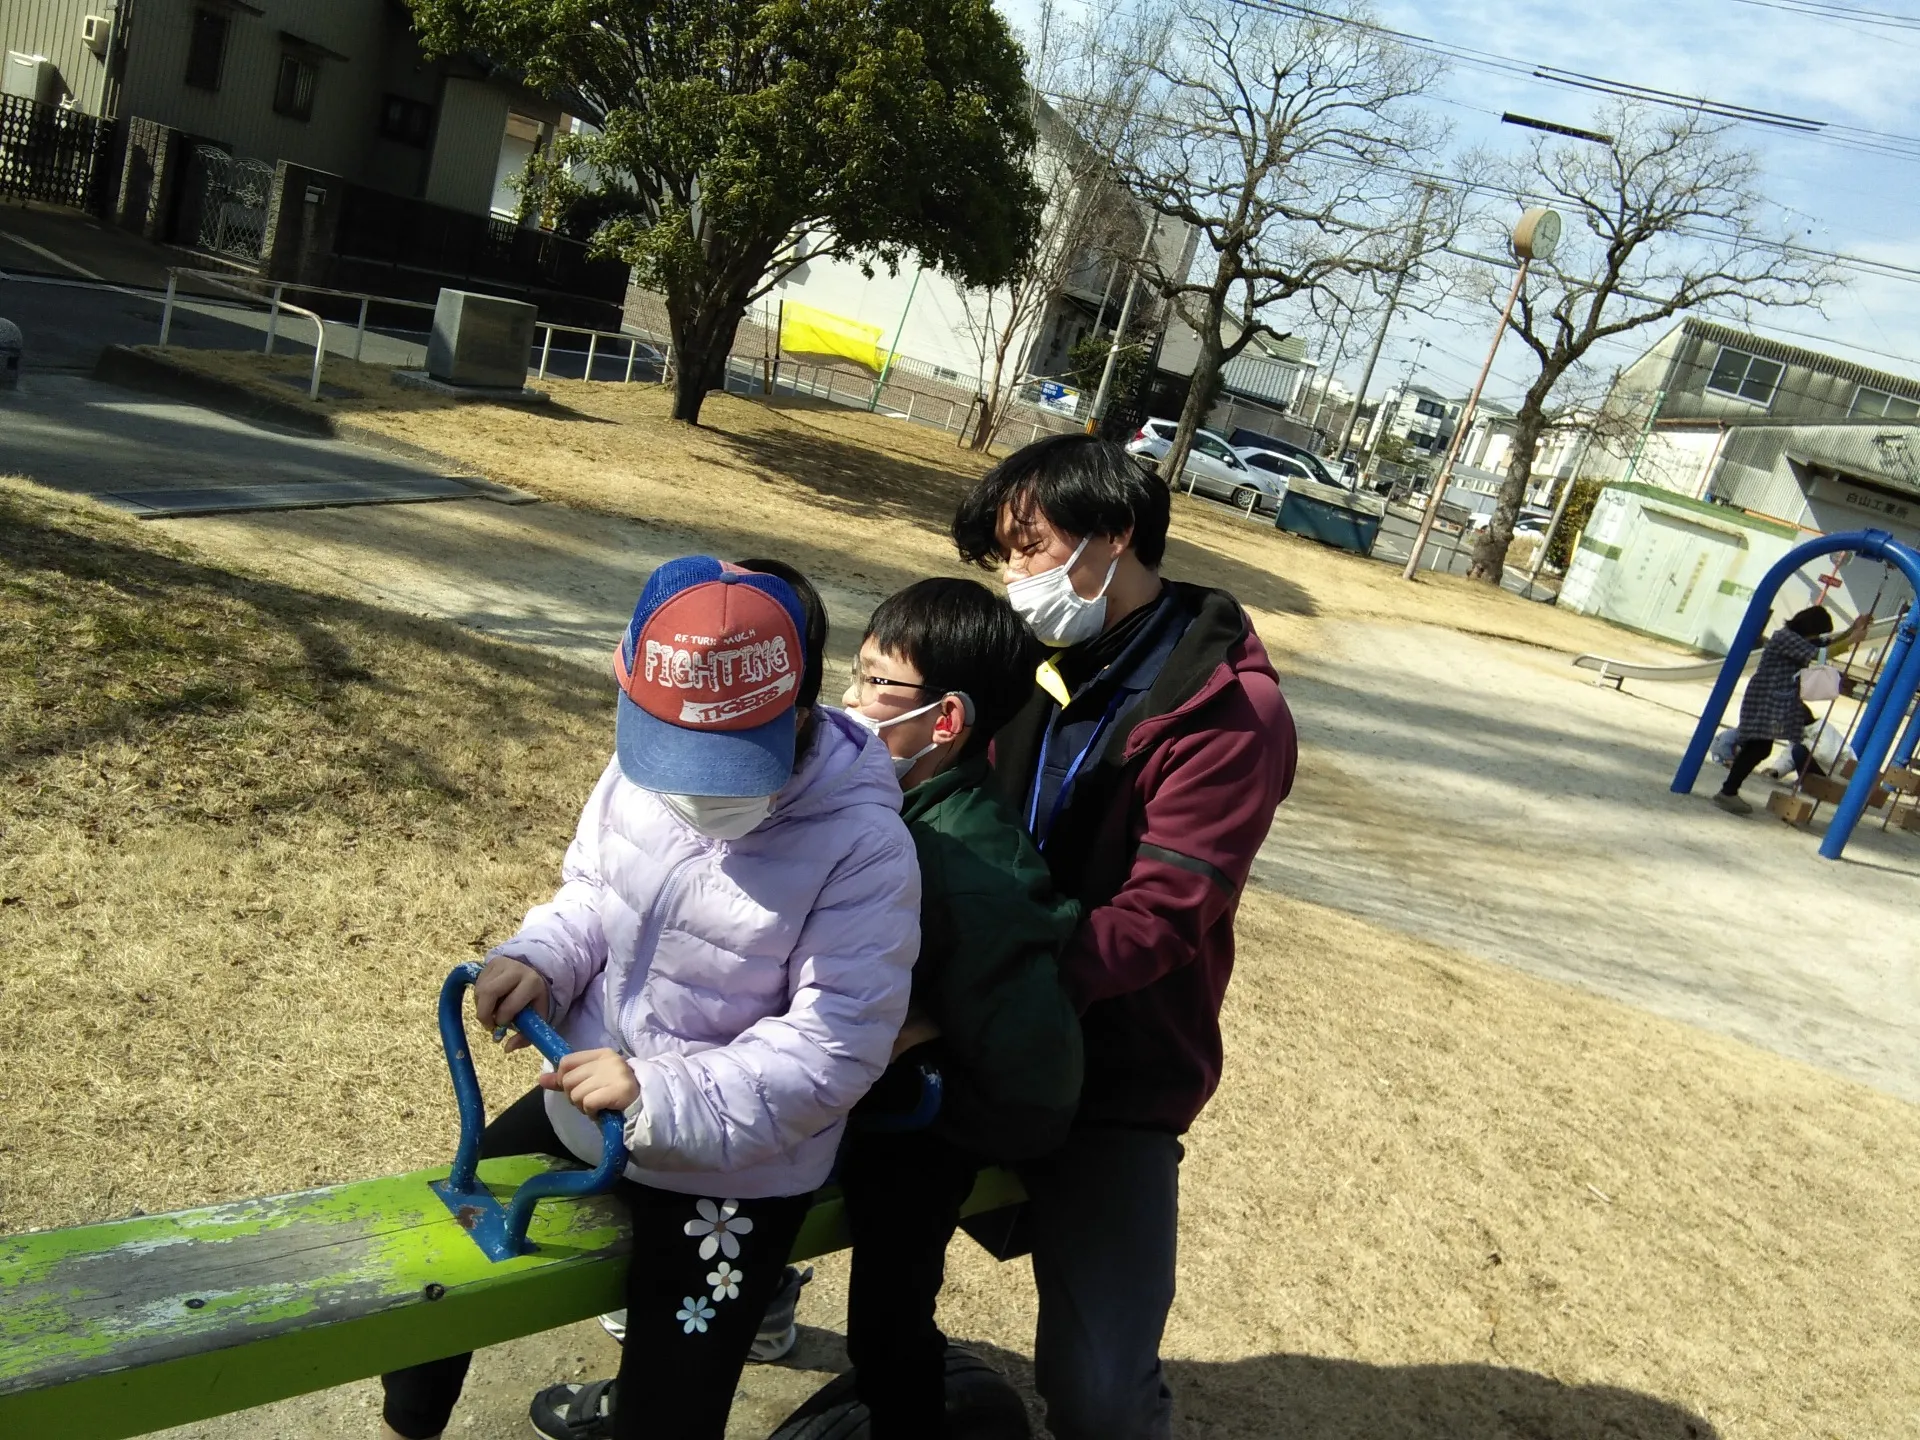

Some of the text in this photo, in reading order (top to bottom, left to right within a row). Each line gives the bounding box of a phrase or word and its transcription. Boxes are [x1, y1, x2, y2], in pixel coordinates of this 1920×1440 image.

[724, 629, 756, 644] MUCH
[645, 635, 789, 692] FIGHTING
[699, 686, 780, 720] TIGERS
